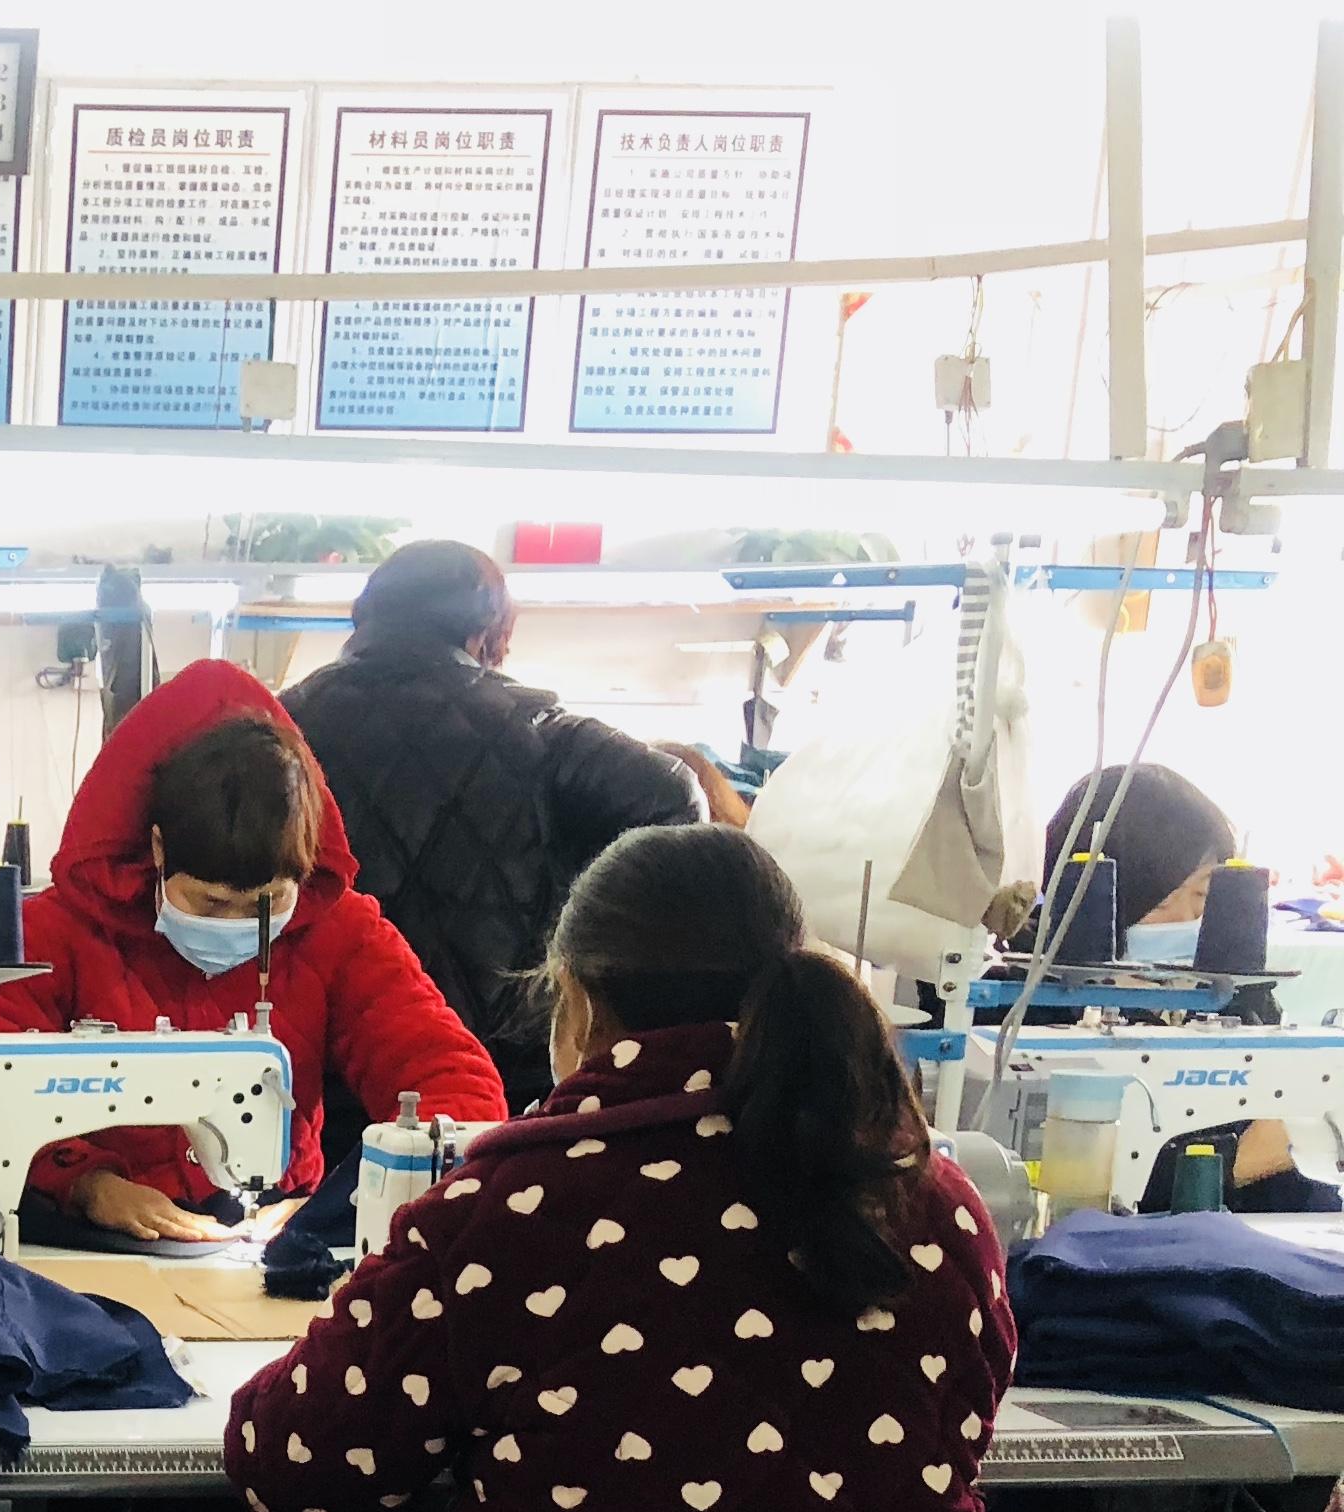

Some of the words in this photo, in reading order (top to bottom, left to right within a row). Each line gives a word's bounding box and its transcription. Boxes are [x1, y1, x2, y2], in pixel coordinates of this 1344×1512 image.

[106, 127, 255, 148] 质检员岗位职责
[368, 130, 516, 150] 材料员岗位职责
[620, 132, 784, 153] 技术负责人岗位职责
